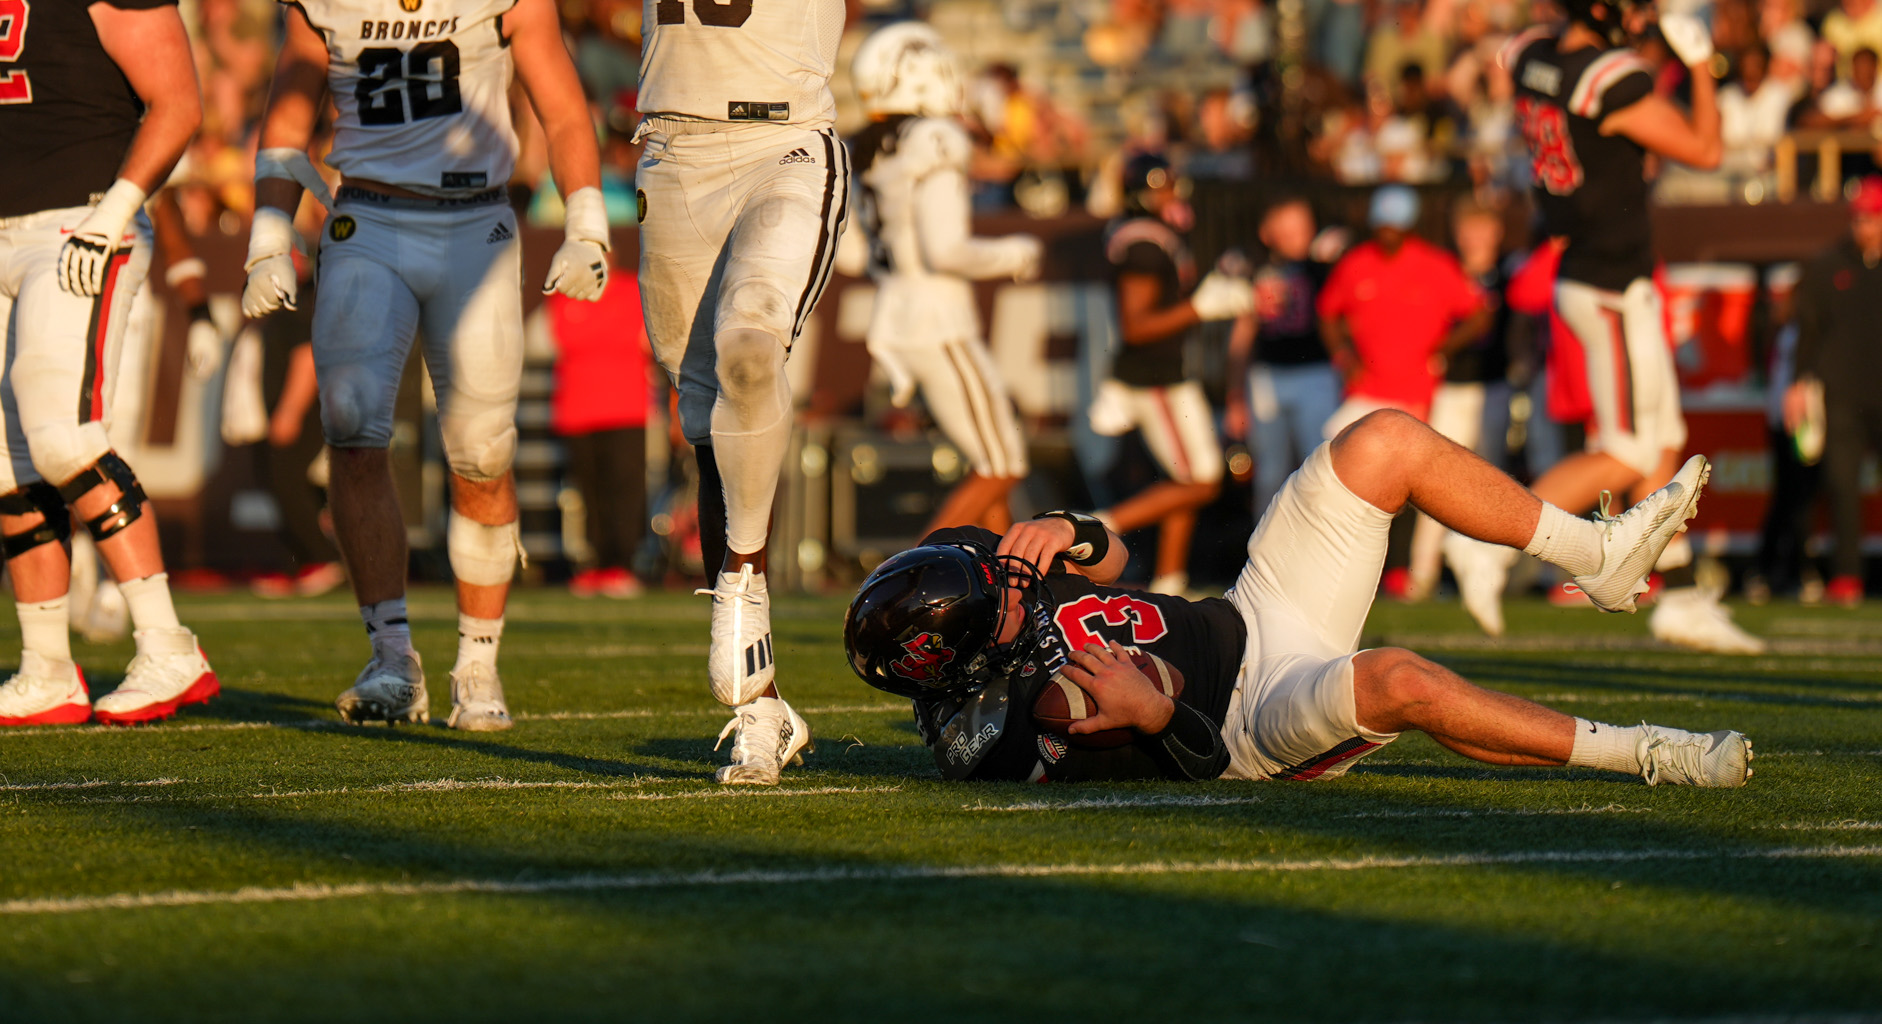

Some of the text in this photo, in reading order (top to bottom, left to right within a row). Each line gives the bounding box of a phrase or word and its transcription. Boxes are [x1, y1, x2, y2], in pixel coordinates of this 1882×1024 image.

[359, 16, 461, 40] BRONCOS
[778, 156, 816, 166] adidas
[946, 731, 968, 765] PRO
[960, 723, 999, 765] GEAR
